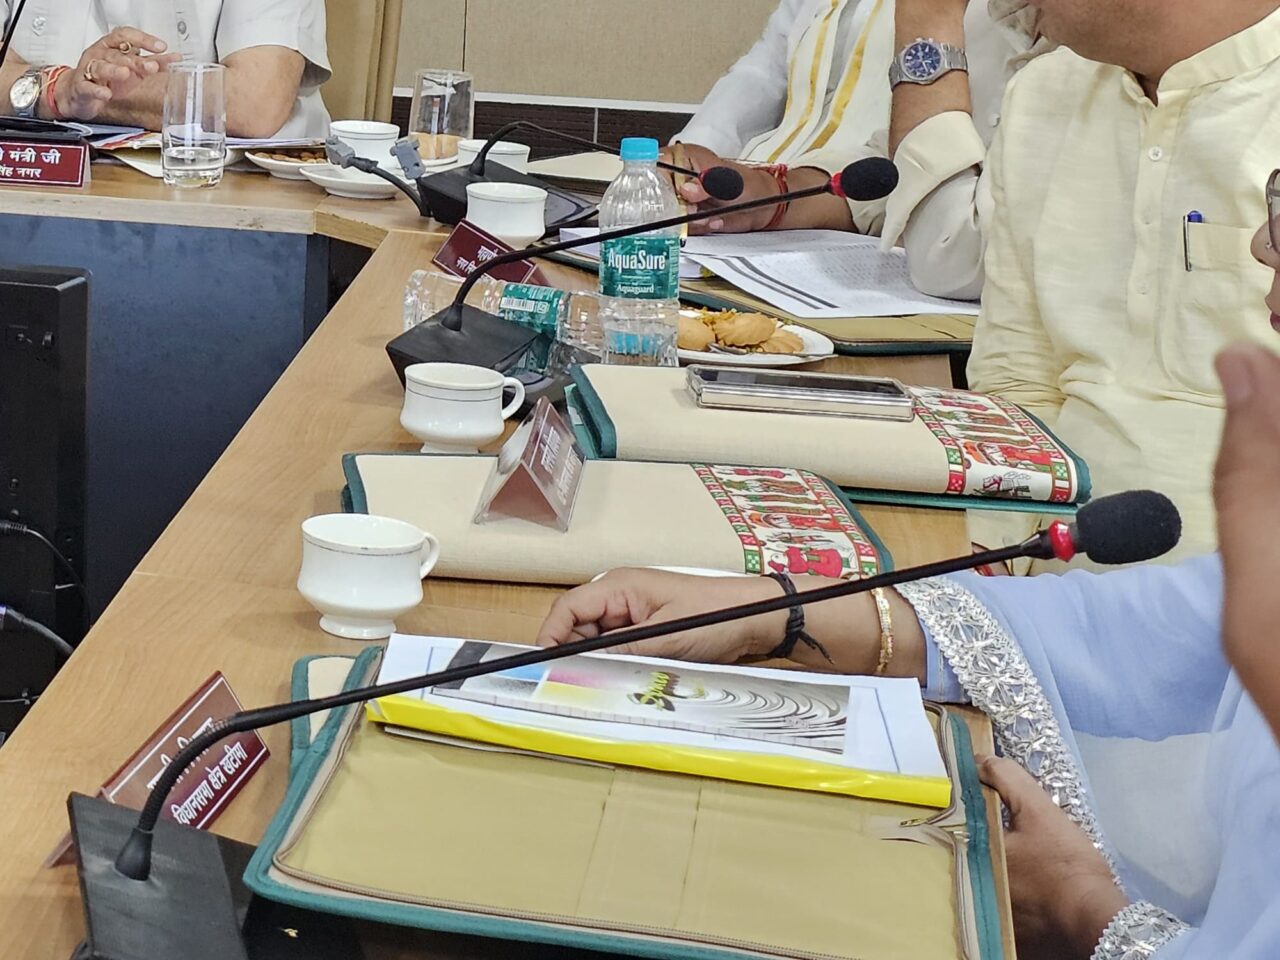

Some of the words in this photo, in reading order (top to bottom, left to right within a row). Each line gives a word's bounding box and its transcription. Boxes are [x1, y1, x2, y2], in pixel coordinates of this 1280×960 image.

[9, 147, 36, 163] मंत्री
[41, 149, 60, 164] जी
[17, 167, 42, 178] नगर
[608, 248, 666, 273] AquaSure
[617, 283, 654, 294] Aquaguard
[205, 765, 228, 790] क्षेत्र
[220, 741, 248, 775] खटीमा
